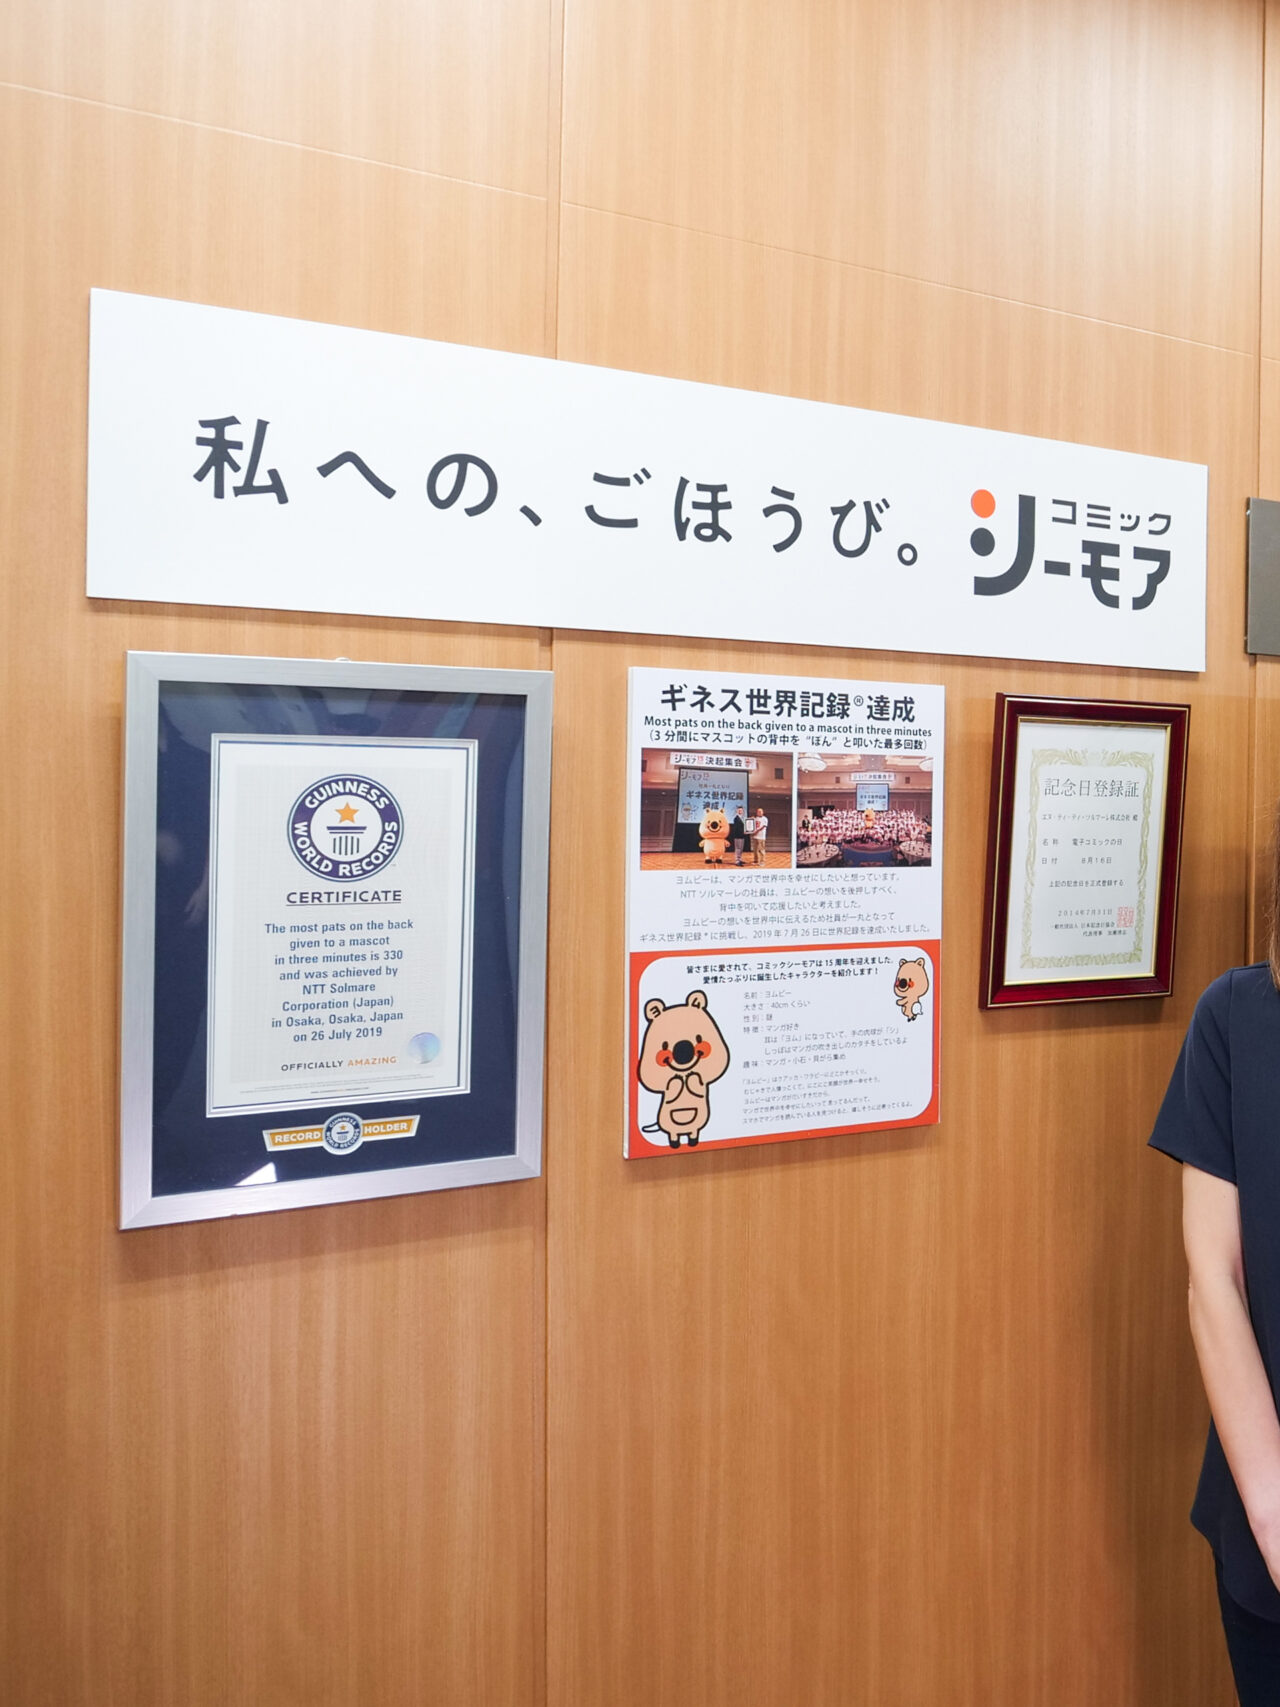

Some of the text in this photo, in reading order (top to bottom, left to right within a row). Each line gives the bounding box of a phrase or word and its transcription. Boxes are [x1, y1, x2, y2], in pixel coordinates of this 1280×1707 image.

[193, 415, 918, 566] 私への、ごほうび。
[1052, 498, 1171, 535] コミック
[970, 488, 1171, 610] シーモア
[644, 715, 672, 727] Most
[674, 717, 699, 729] pats
[701, 719, 715, 728] on
[717, 719, 735, 729] the
[738, 719, 763, 730] back
[765, 720, 793, 733] given
[796, 723, 807, 732] to
[817, 724, 853, 734] mascot
[854, 725, 864, 735] in
[866, 725, 892, 736] three
[894, 726, 932, 737] minutes
[705, 755, 743, 767] 決起集会
[305, 781, 389, 809] GUINNESS
[1044, 778, 1140, 798] 記念日登録証
[294, 821, 398, 876] WORLD RECORDS
[286, 890, 402, 904] CERTIFICATE
[265, 919, 413, 934] The most pats on the back
[290, 936, 390, 951] given to a mascot
[274, 950, 403, 965] in three minutes is 330
[280, 966, 398, 981] and was achieved by
[303, 982, 376, 995] NTT Solmare
[282, 995, 394, 1013] Corporation (Japan)
[271, 1018, 282, 1028] in
[286, 1015, 325, 1027] Osaka,
[370, 1011, 404, 1024] Japan
[293, 1026, 383, 1042] on 26 July 2019
[280, 1056, 397, 1072] OFFICIALLY AMAZING
[274, 1122, 408, 1143] RECORD HOLDER
